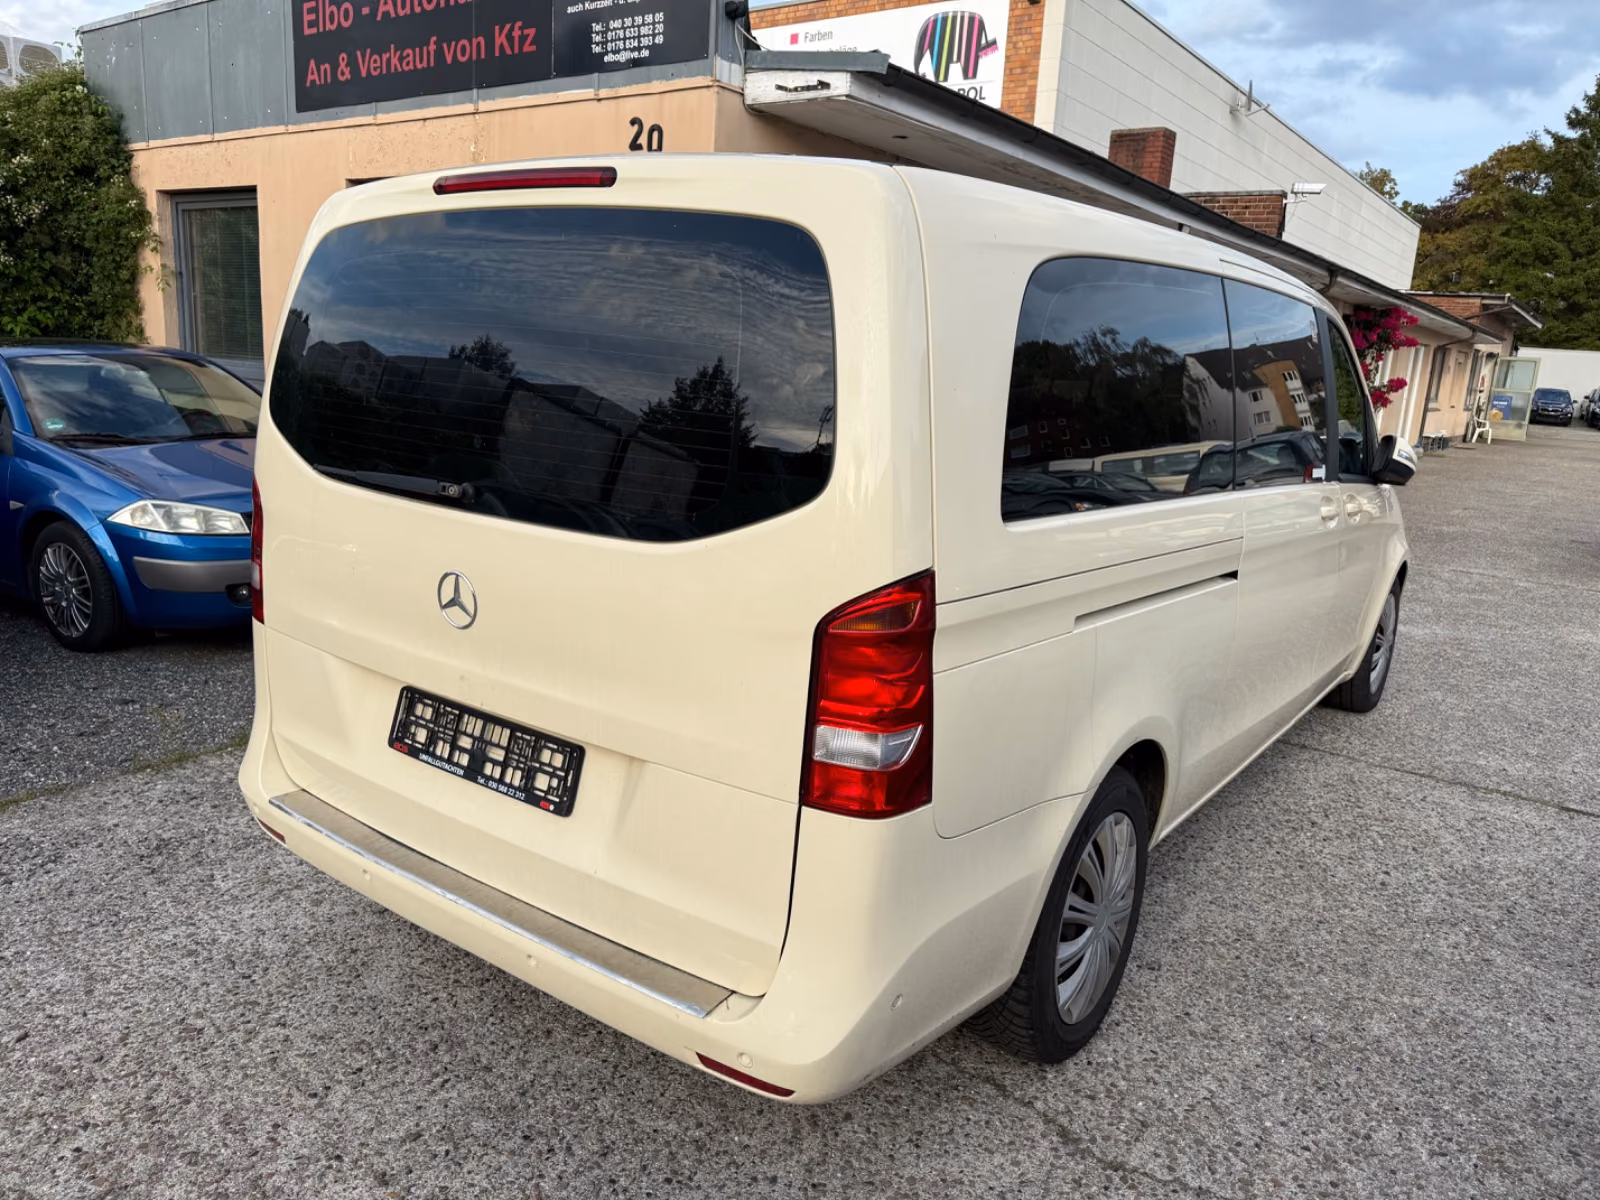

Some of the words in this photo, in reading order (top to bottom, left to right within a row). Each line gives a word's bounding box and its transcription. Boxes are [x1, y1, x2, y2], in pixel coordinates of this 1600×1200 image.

[302, 0, 354, 35] Elbo
[566, 4, 584, 14] auch
[591, 22, 606, 32] Tel.:
[623, 16, 633, 28] 30
[633, 15, 643, 26] 39
[643, 13, 654, 24] 58
[654, 11, 665, 22] 05
[591, 33, 606, 43] Tel.:
[606, 29, 625, 40] 0176
[654, 23, 664, 34] 20
[804, 30, 834, 43] Farben
[305, 58, 331, 87] An
[337, 52, 352, 82] &
[355, 36, 437, 78] Verkauf
[442, 35, 486, 65] von
[494, 20, 537, 57] Kfz
[591, 44, 606, 54] Tel.:
[606, 40, 625, 51] 0176
[654, 34, 664, 45] 49
[603, 48, 650, 63] elbo@live.de
[628, 116, 664, 152] 20
